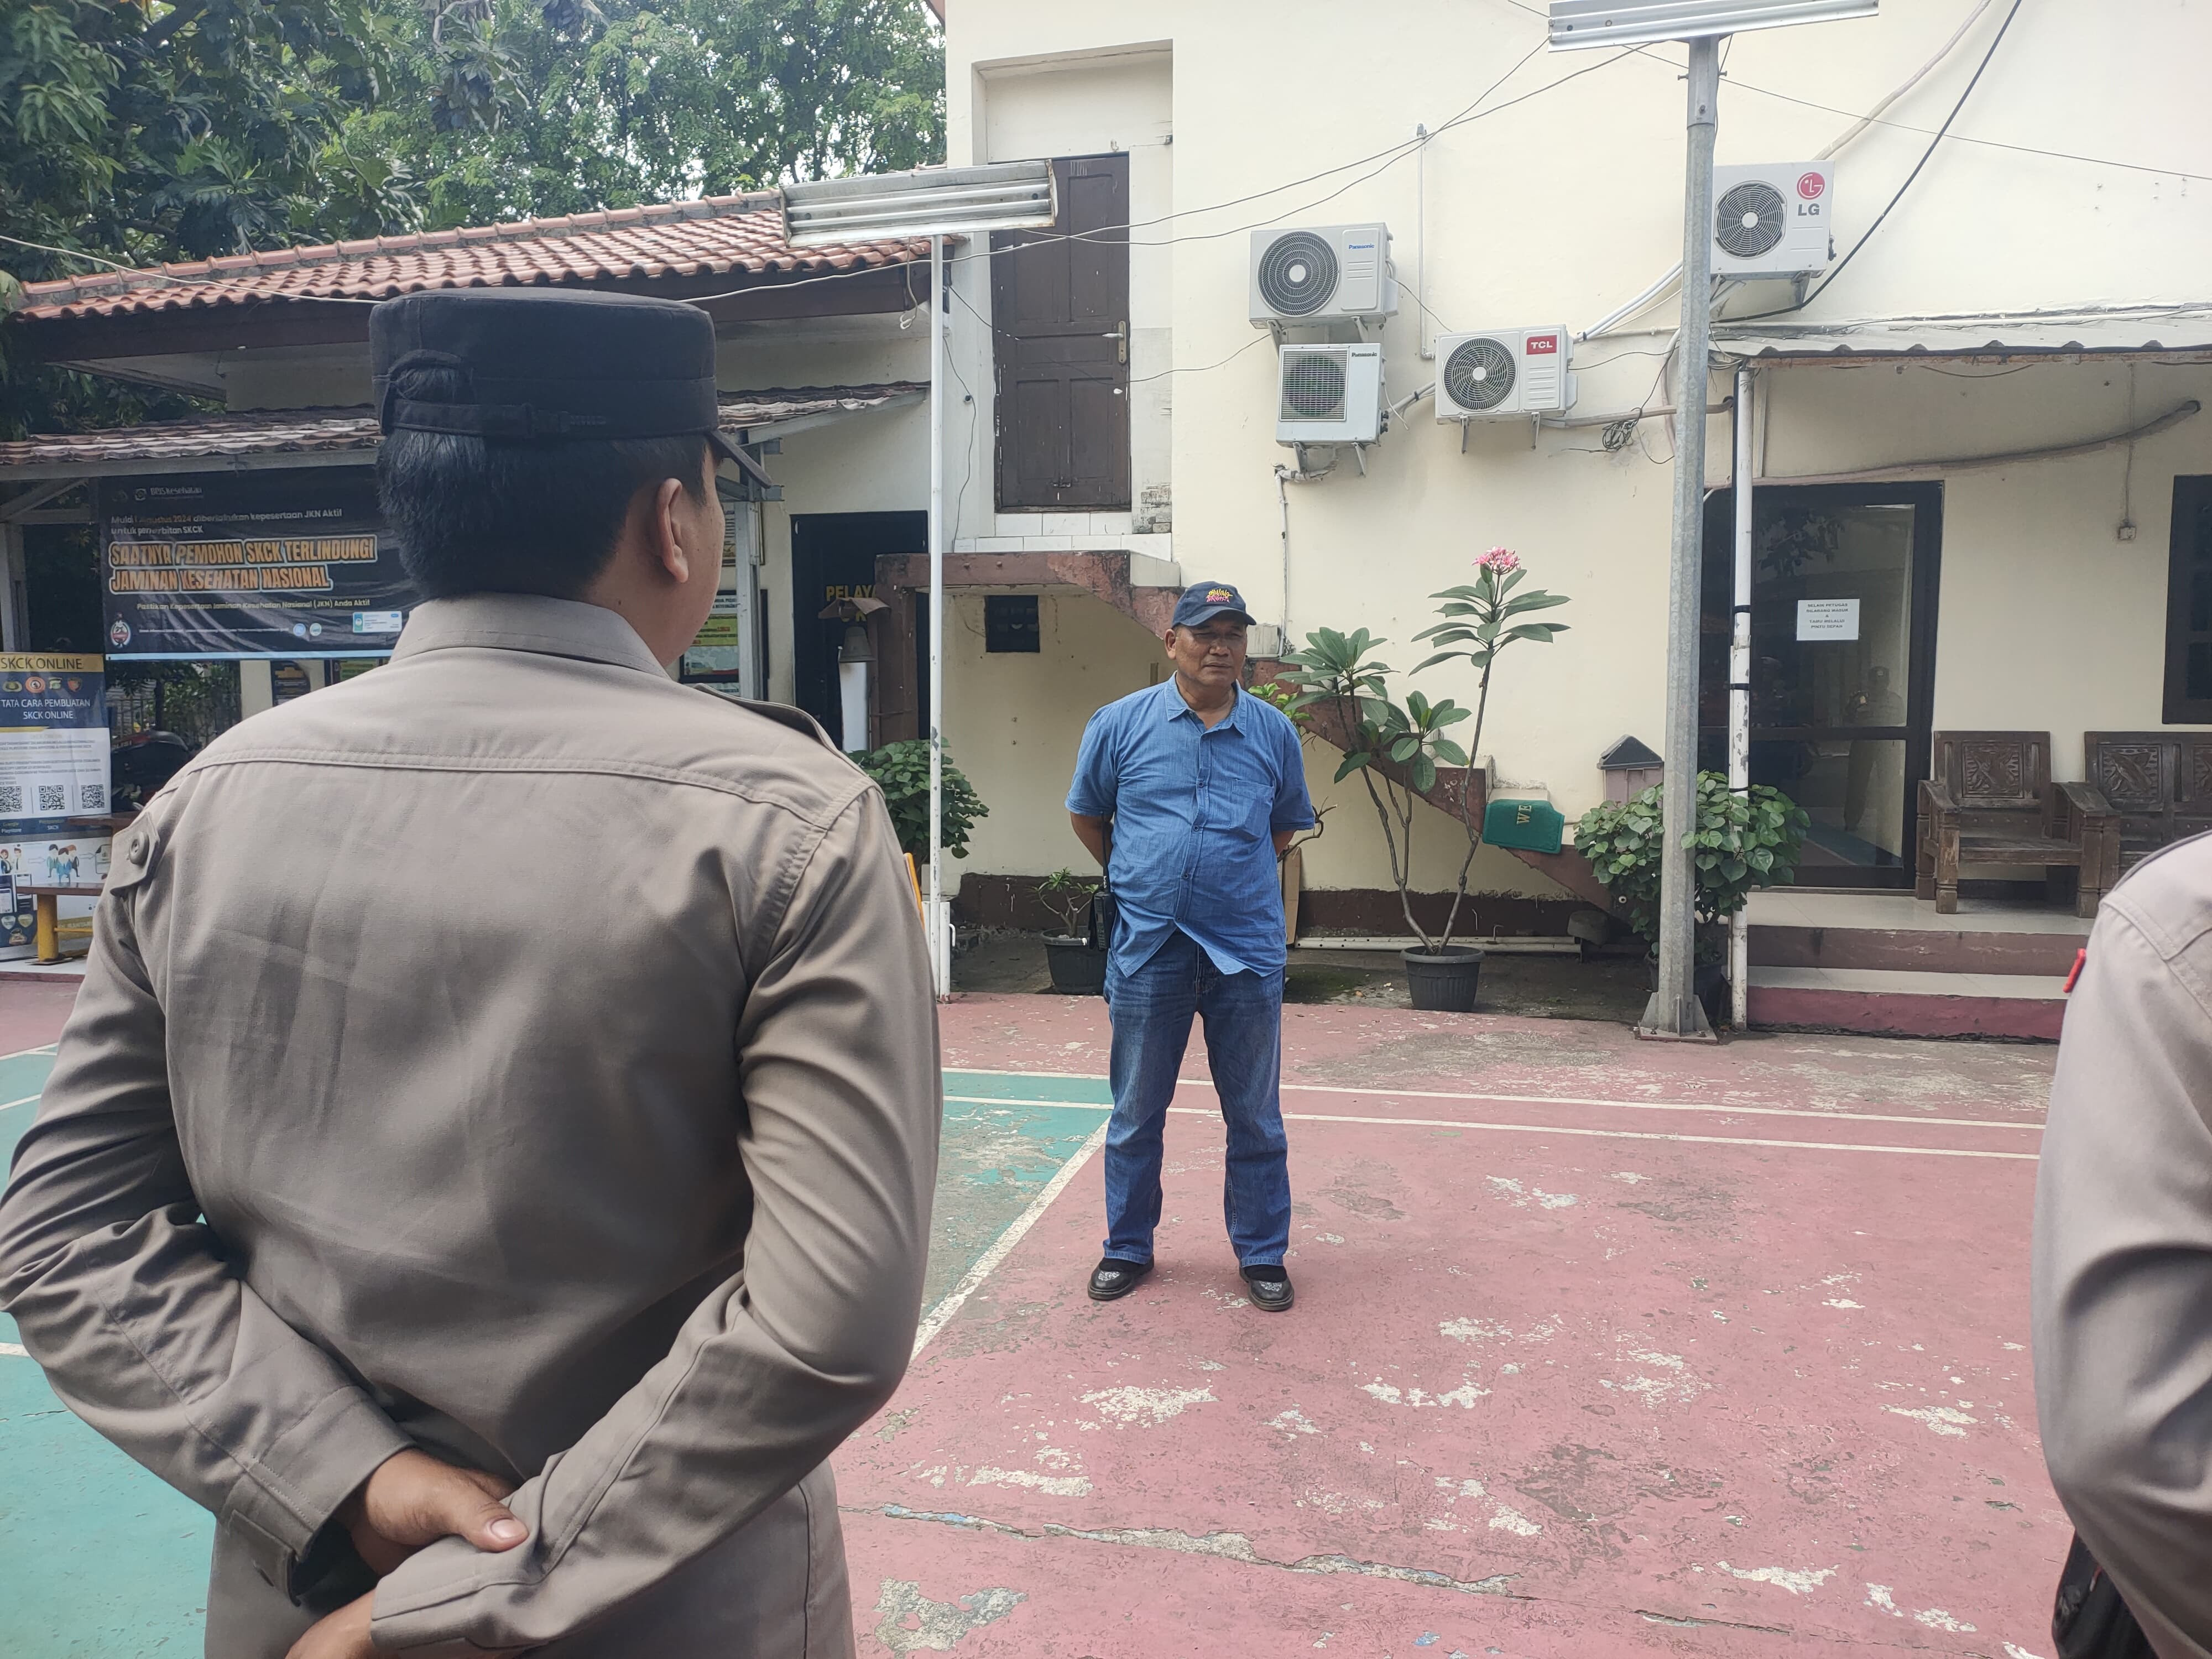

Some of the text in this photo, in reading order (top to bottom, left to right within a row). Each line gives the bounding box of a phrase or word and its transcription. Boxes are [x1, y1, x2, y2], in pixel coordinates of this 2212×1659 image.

[1798, 204, 1820, 216] LG
[1530, 341, 1553, 349] TCL
[250, 512, 303, 521] kepesertaan
[304, 509, 321, 518] JKN
[322, 508, 342, 517] Aktif
[111, 525, 204, 536] untuk penerbitan SKCK
[112, 538, 374, 565] SAATNYA PEMOHON SKCK TERLINDUNGI
[112, 566, 330, 591] JAMINAN KESEHATAN NASIONAL
[1208, 588, 1233, 597] SHINING
[283, 600, 312, 608] Nasional
[354, 598, 371, 606] Aktif
[1, 657, 84, 669] SKCK ONLINE
[1, 698, 91, 708] TATA CARA PEMBUATAN
[23, 711, 74, 719] SKCK ONLINE
